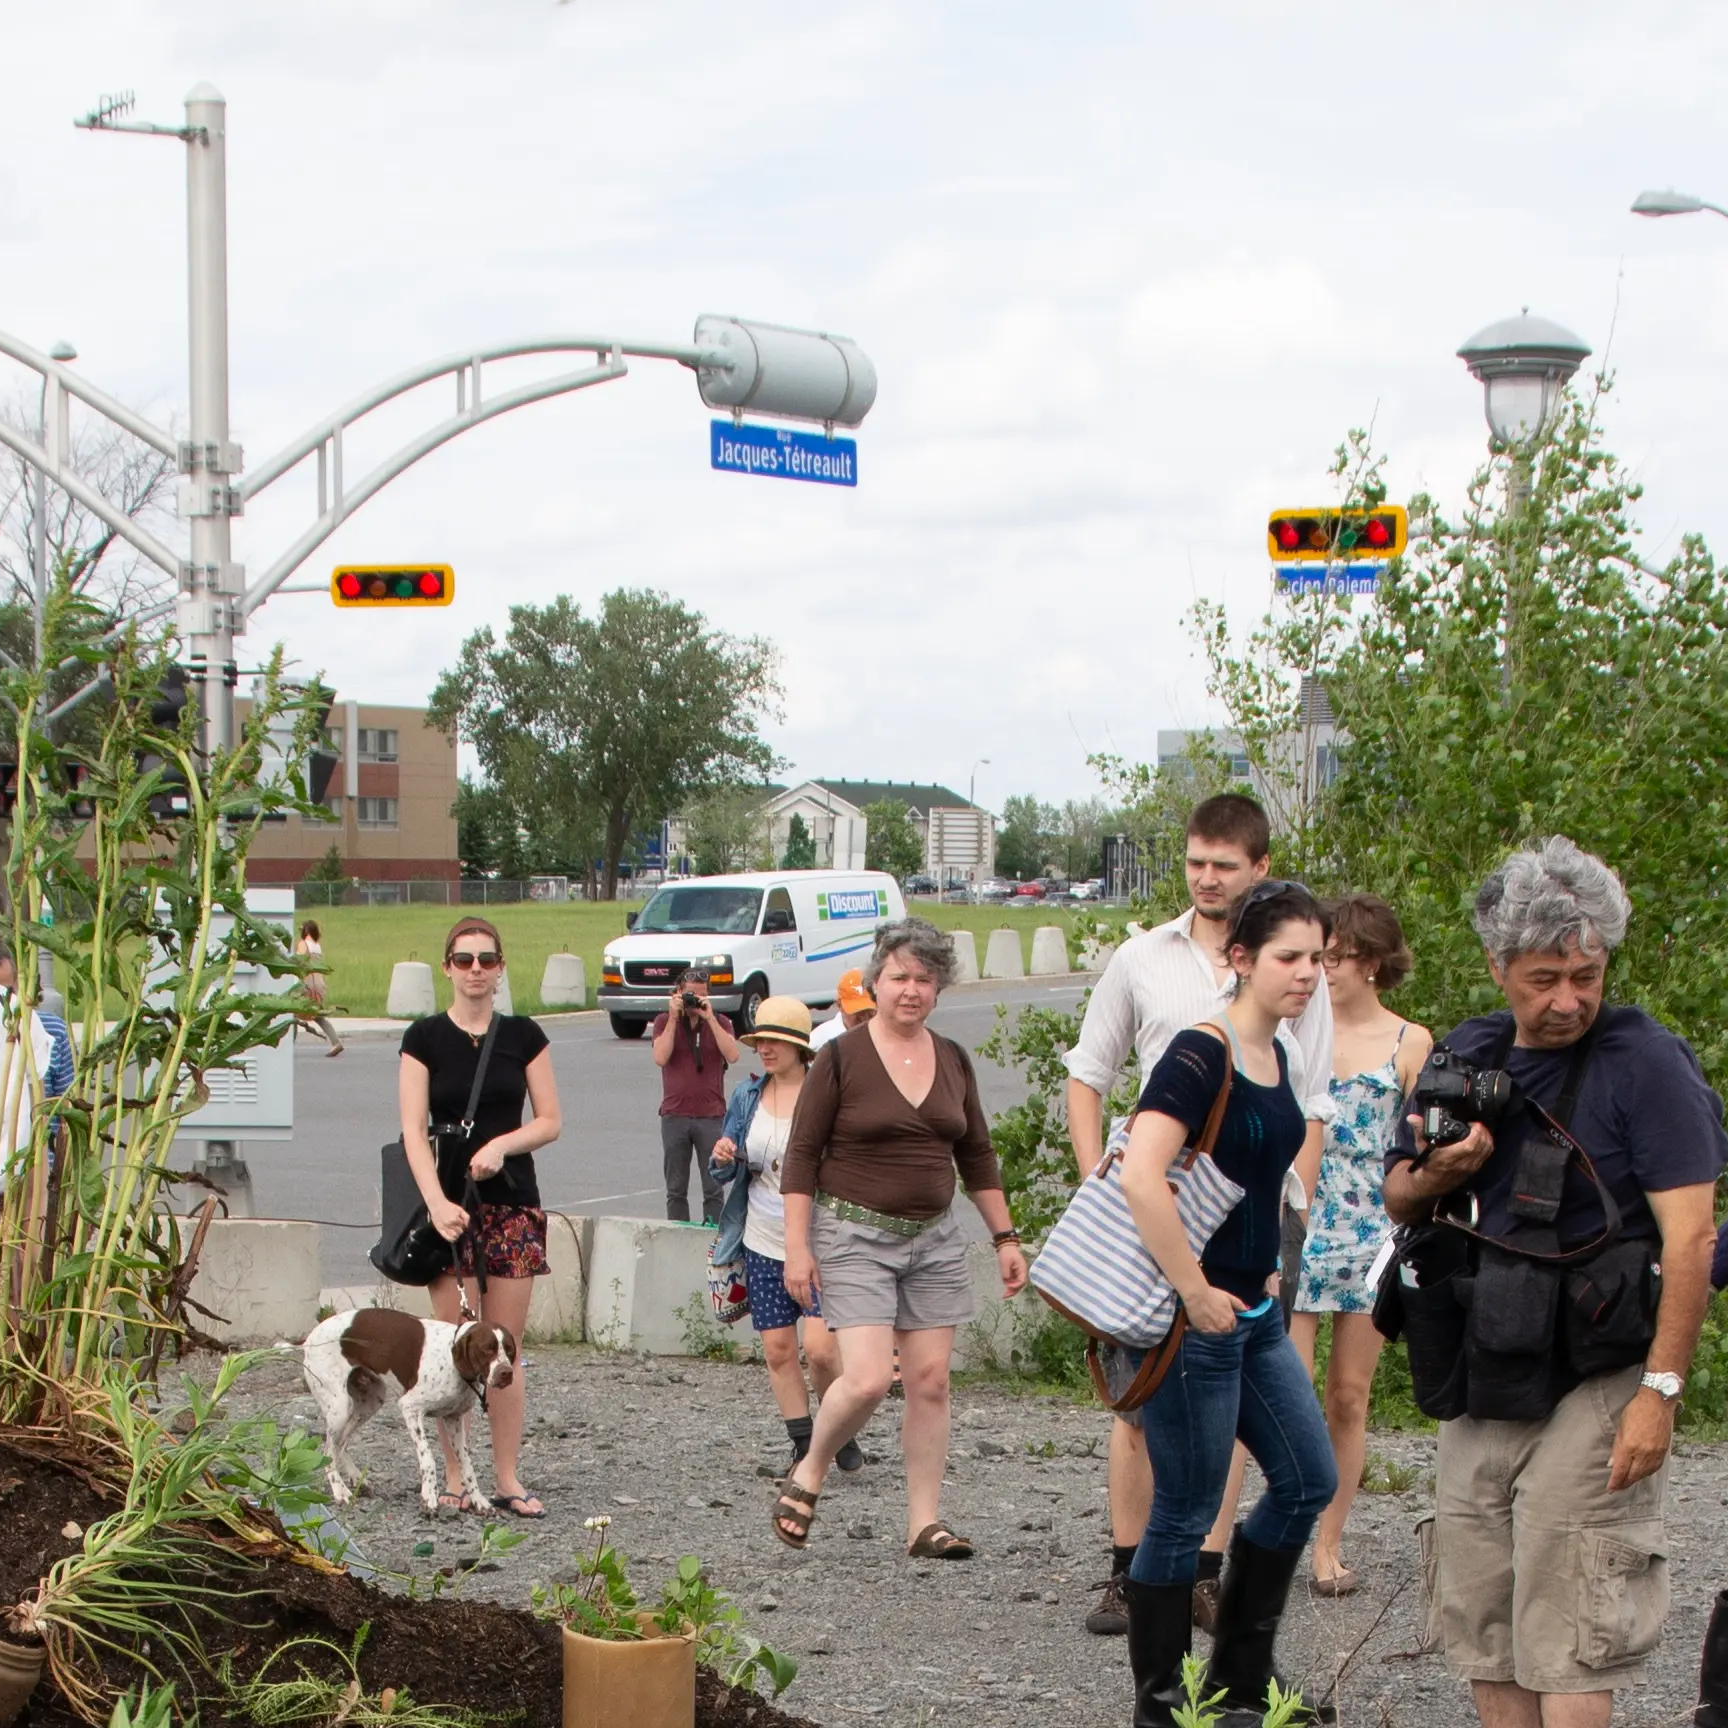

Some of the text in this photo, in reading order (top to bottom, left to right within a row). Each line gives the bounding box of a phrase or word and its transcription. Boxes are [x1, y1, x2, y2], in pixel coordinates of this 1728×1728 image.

[776, 429, 792, 443] Rue
[718, 437, 852, 480] Jacques-Tétreault
[831, 892, 876, 913] Discount
[643, 968, 670, 976] GMC
